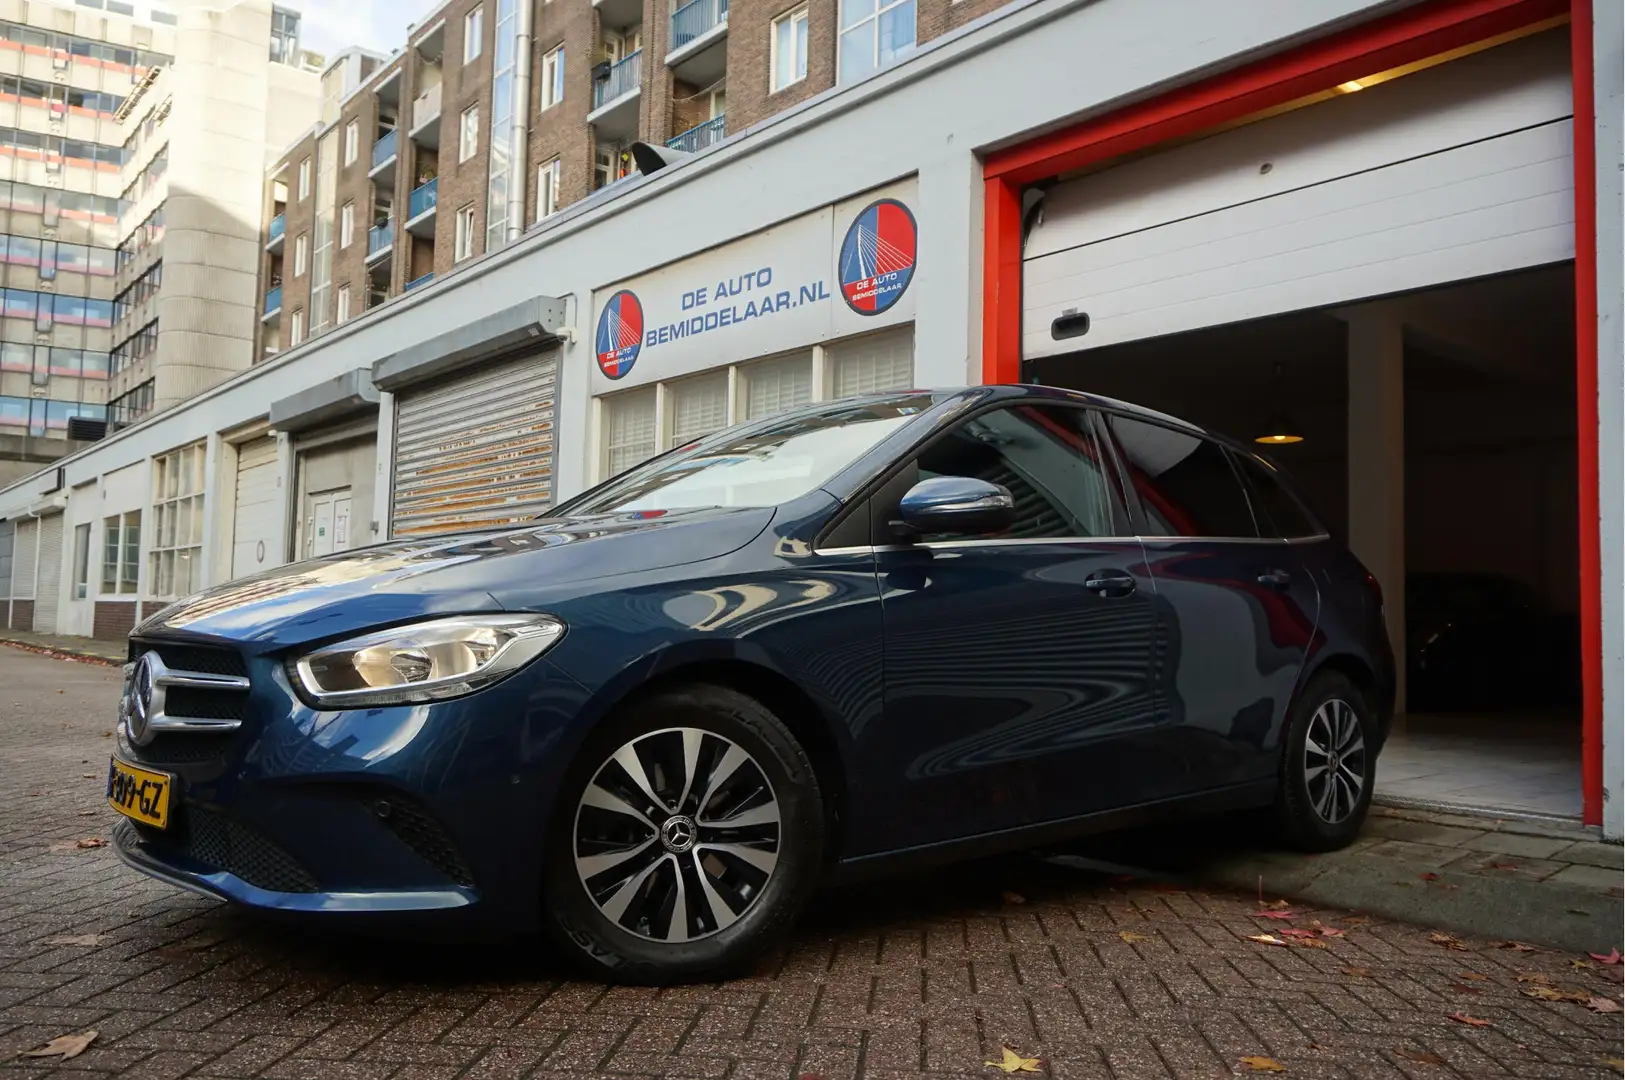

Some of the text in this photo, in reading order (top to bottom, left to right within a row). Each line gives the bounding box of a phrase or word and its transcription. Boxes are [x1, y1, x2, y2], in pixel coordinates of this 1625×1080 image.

[681, 267, 773, 311] DE AUTO
[856, 272, 898, 290] DE AUTO
[852, 282, 902, 301] BEMIDDELAAR
[645, 280, 831, 348] BEMIDDELAAR.NL
[606, 347, 632, 360] DE AUTO
